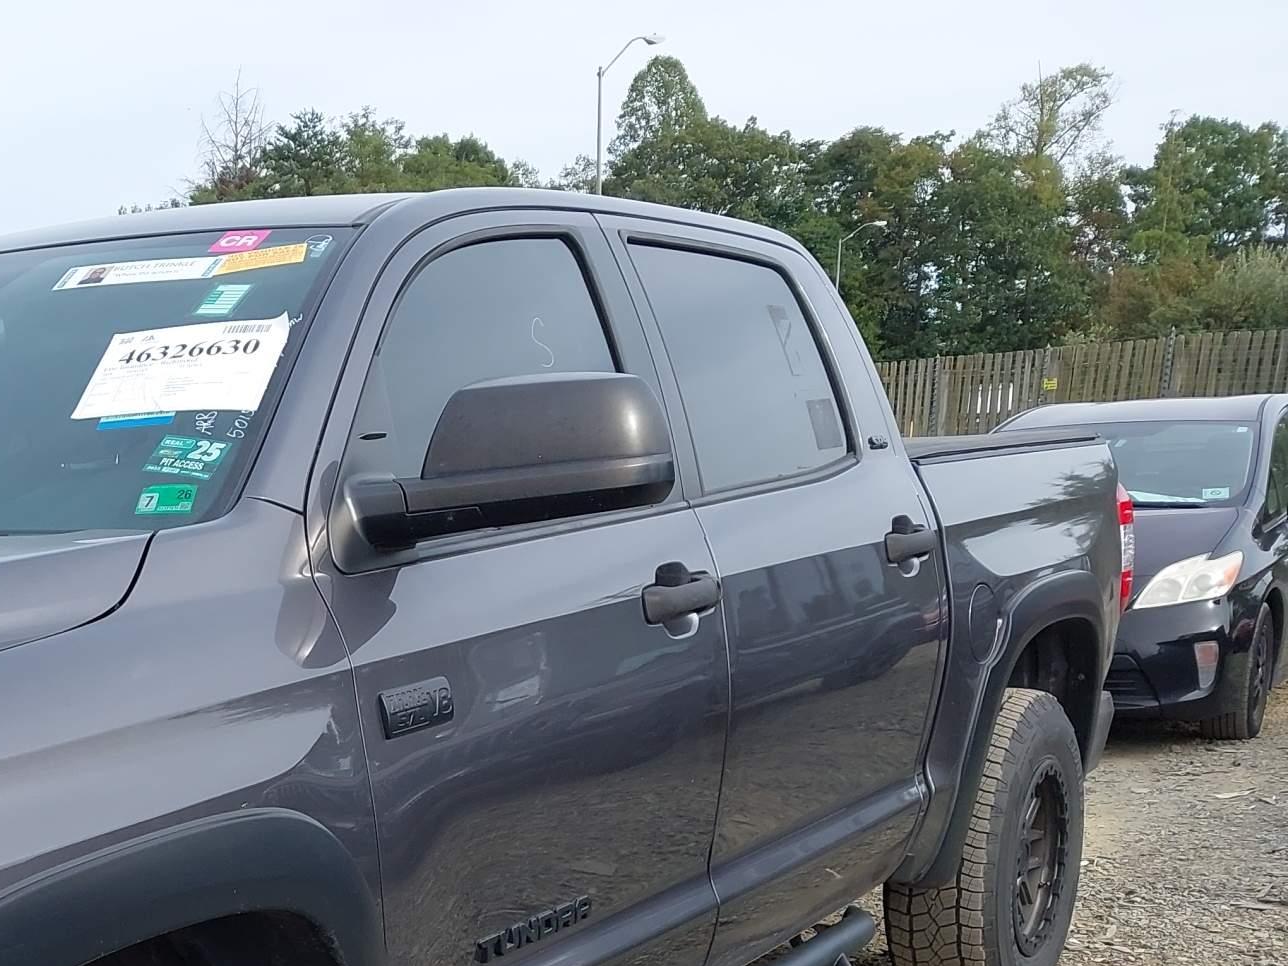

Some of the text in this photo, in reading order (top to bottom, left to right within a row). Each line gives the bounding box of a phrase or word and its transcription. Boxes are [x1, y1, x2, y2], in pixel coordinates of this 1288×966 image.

[219, 234, 258, 247] CR
[118, 338, 261, 364] 46326630
[186, 440, 227, 461] 25
[159, 457, 205, 471] PIT ACCESS
[144, 495, 155, 508] 7
[177, 489, 193, 500] 26
[473, 895, 593, 964] TUNDRA
